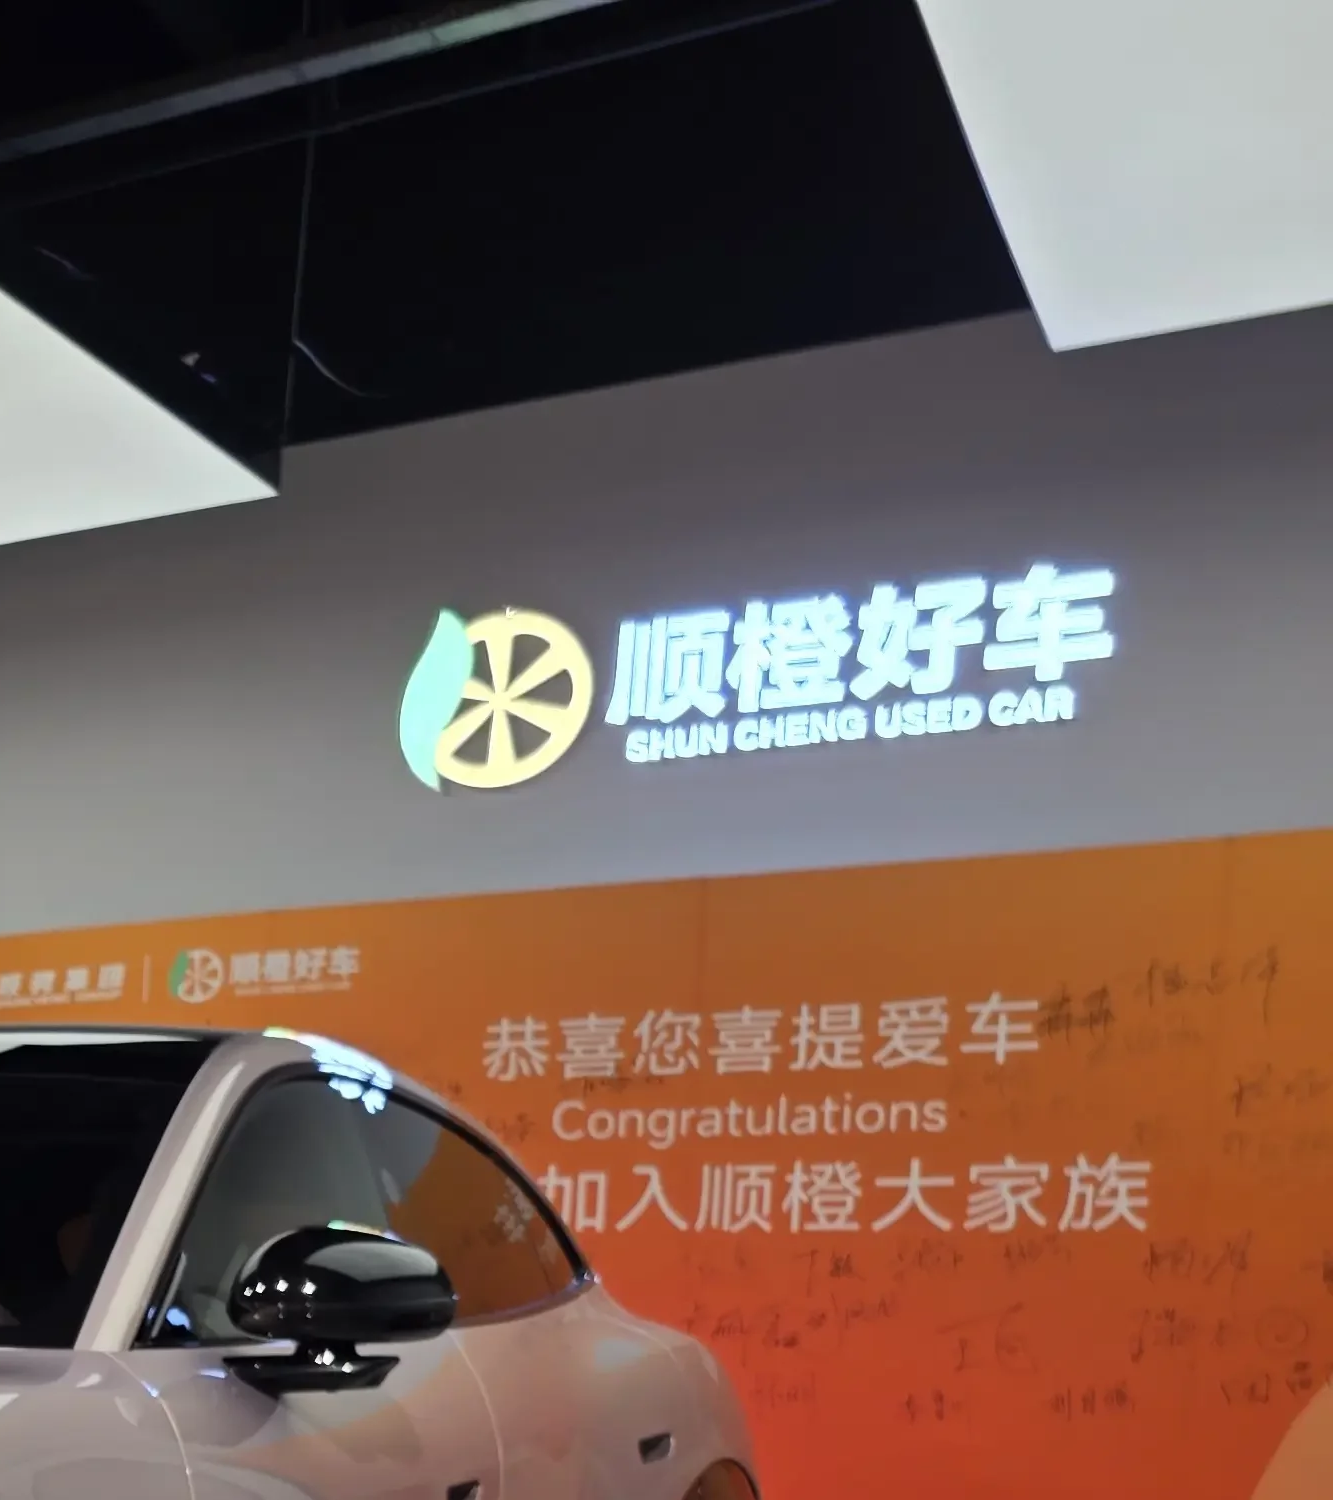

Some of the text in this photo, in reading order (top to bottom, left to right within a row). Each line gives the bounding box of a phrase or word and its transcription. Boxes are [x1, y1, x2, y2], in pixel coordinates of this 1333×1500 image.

[605, 562, 1115, 726] 顺橙好车
[625, 684, 1074, 763] SHUN CHENG USED CAR
[482, 991, 1041, 1082] 恭喜您喜提爱车
[551, 1092, 948, 1149] Congratulations
[536, 1152, 1153, 1234] 加入顺橙大家族
